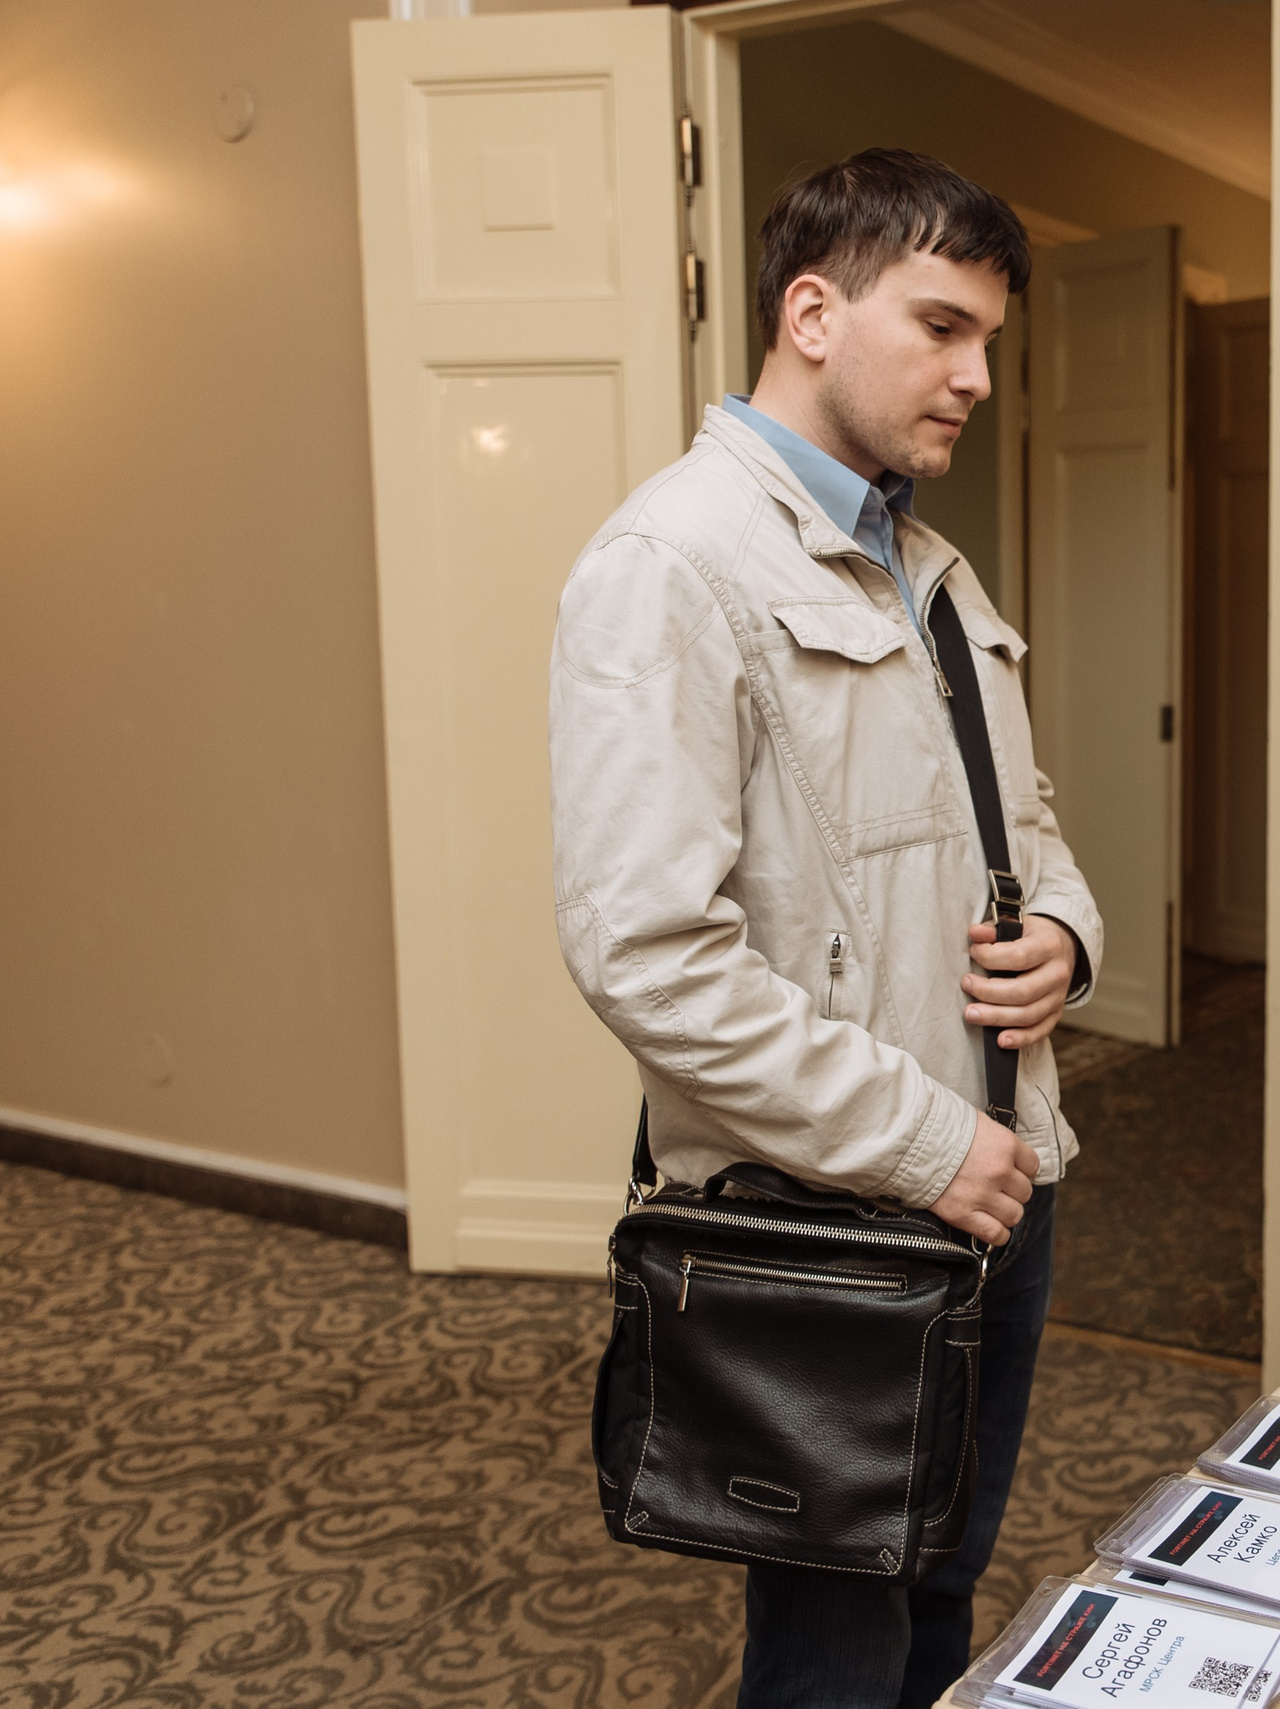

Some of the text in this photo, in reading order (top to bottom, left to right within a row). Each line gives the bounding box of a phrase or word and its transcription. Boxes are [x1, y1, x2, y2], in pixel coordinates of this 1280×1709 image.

[1206, 1513, 1261, 1564] Алексей
[1233, 1525, 1278, 1563] Камко
[1081, 1622, 1136, 1679] Сергей
[1100, 1617, 1168, 1698] Агафонов
[1138, 1635, 1186, 1693] МРСК Центра
